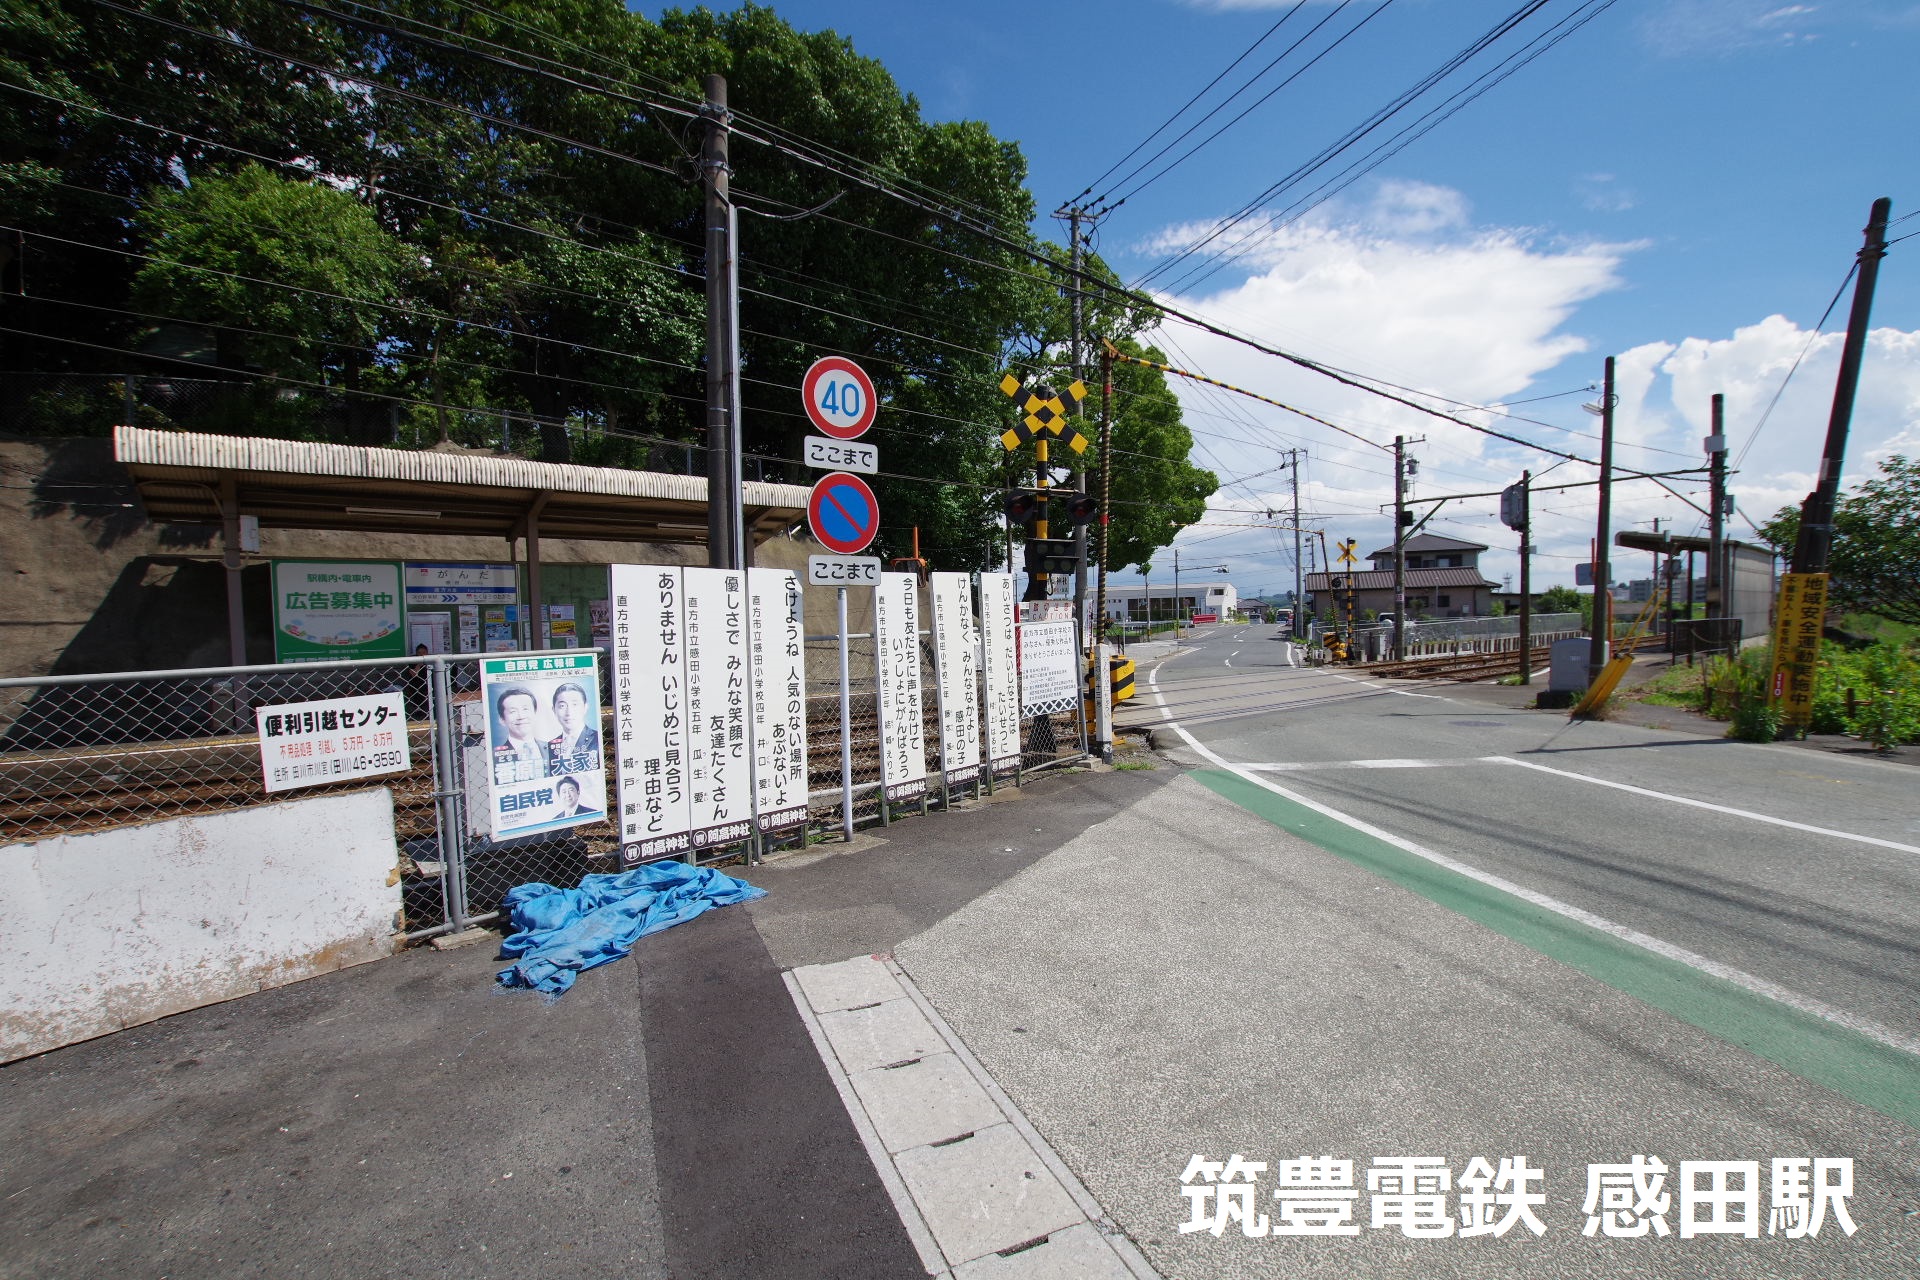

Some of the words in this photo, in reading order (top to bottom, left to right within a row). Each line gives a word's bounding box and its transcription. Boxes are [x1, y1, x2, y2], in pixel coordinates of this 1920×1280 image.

[821, 380, 860, 418] 40
[811, 444, 873, 468] ここまで
[286, 592, 393, 610] 広告募集中
[725, 576, 740, 645] 優しさで
[814, 562, 876, 580] ここまで
[958, 578, 968, 643] けんかなく
[1002, 578, 1012, 640] あいさつは
[658, 573, 677, 664] ありません
[784, 576, 800, 656] さけようね
[1790, 577, 1823, 706] 地域安全運動実施中
[505, 660, 538, 671] 自民党
[616, 595, 632, 742] 直方市立感田小学校六年
[688, 598, 701, 734] 直方市立感田小学校五年
[752, 596, 764, 724] 直方市立感田小学校四年
[904, 578, 919, 750] 今日も友だちに声をかけて
[962, 652, 975, 743] みんななかよし
[1006, 647, 1016, 734] だいじなことば
[266, 706, 398, 737] 便利引越センター
[662, 675, 681, 803] いじめに見合う
[726, 656, 743, 758] みんな笑顔で
[787, 666, 802, 780] 人気のない場所
[893, 638, 908, 778] いっしょにがんばろう
[956, 710, 966, 764] 感田の子
[998, 692, 1008, 754] たいせつに
[500, 788, 553, 812] 自民党
[551, 752, 590, 776] 大家
[644, 758, 662, 832] 理由など
[710, 715, 728, 821] 友達たくさん
[772, 724, 788, 806] あぶないよ
